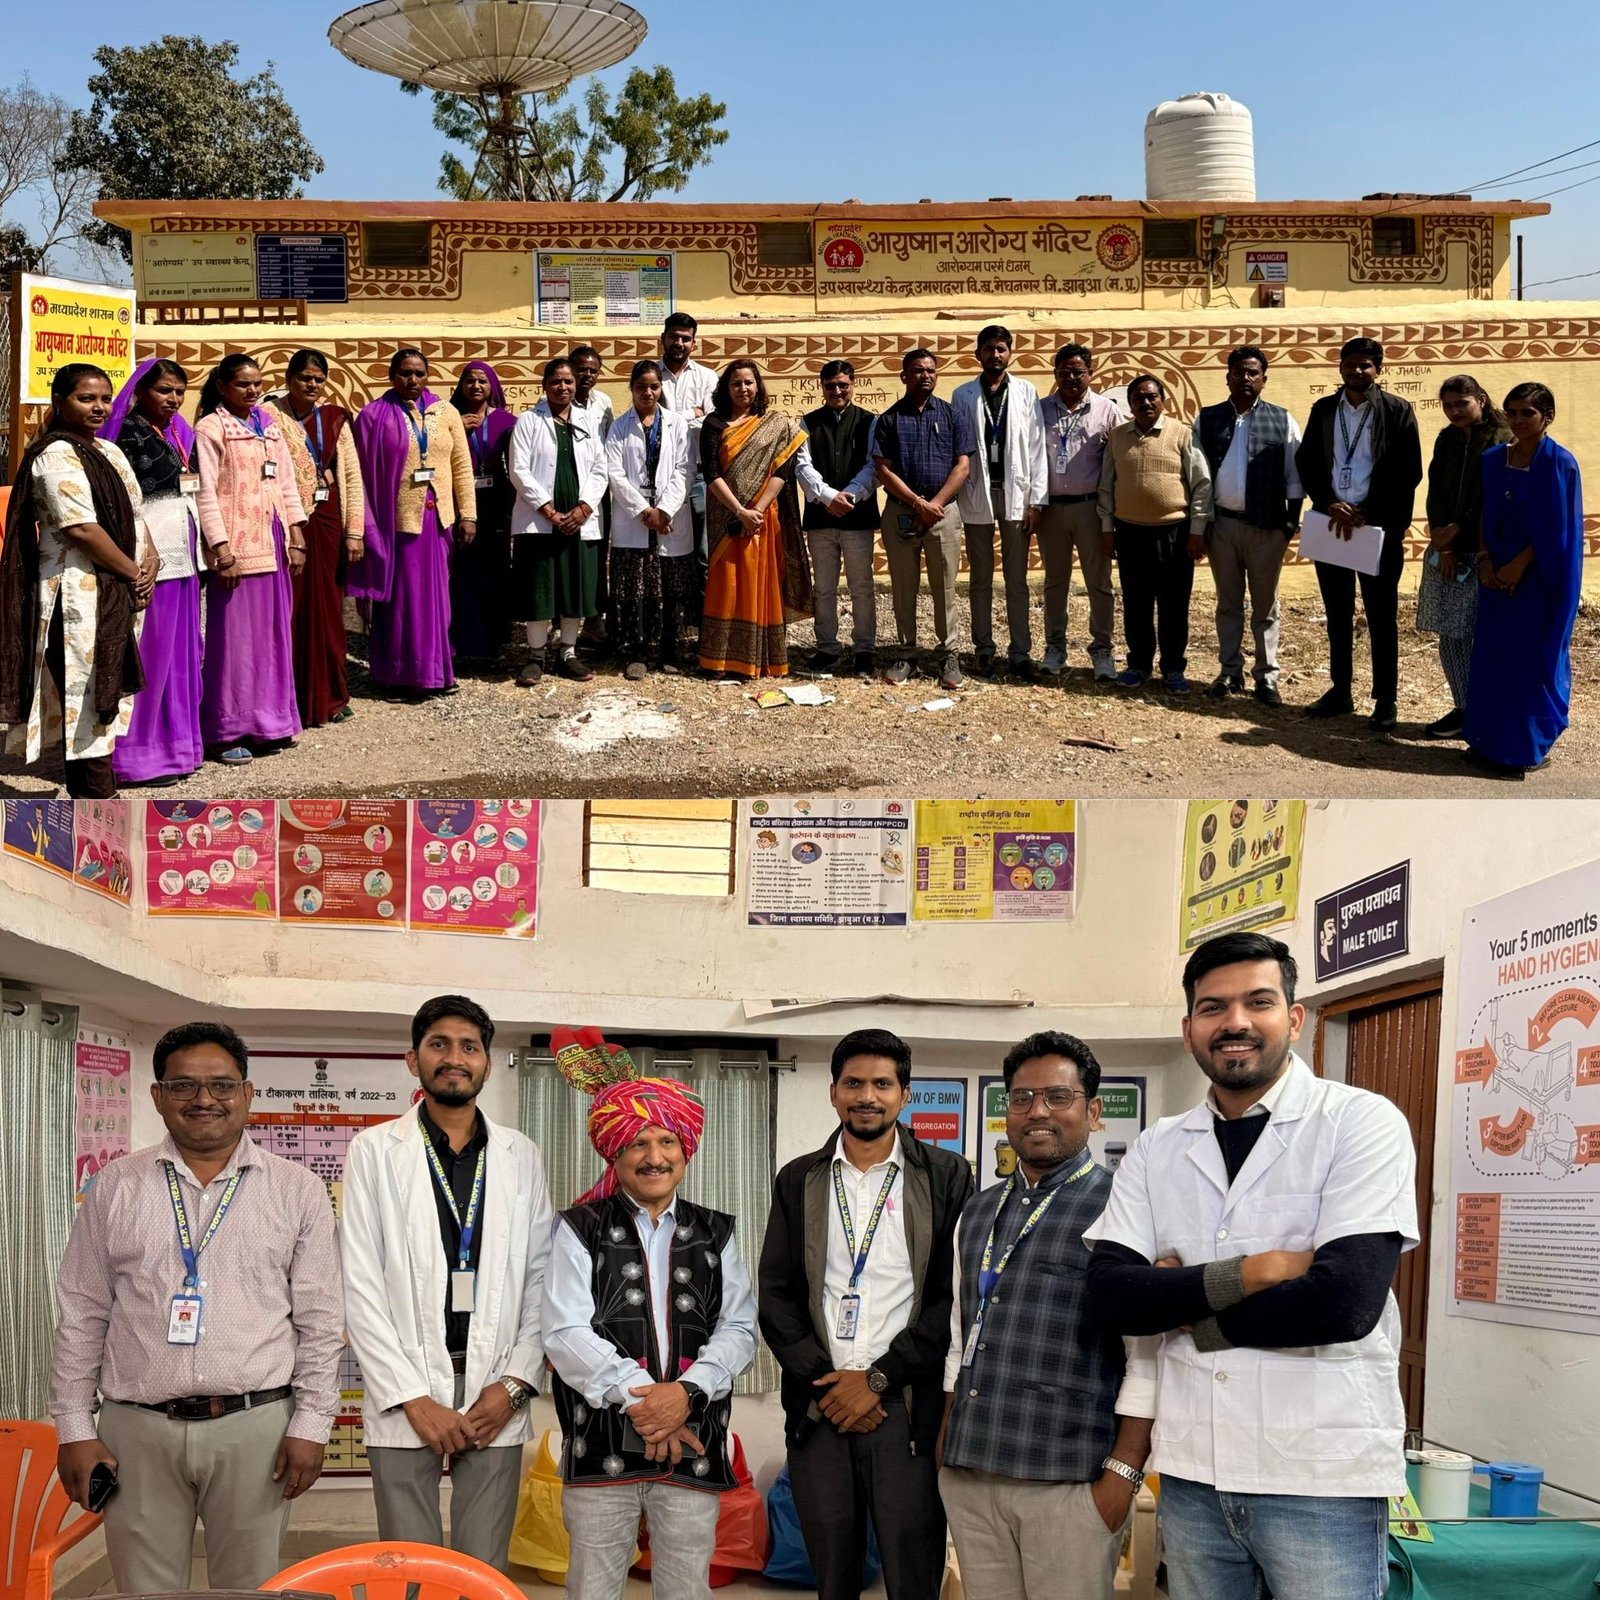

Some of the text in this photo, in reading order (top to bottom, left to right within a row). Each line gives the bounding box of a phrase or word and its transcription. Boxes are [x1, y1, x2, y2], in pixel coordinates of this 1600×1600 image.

[867, 231, 955, 262] आयुष्मान
[956, 224, 1028, 254] आरोग्य
[1032, 223, 1093, 254] मंदिर
[49, 302, 114, 321] मध्यप्रदेश शासन
[76, 326, 106, 356] आरोग्य
[107, 329, 129, 358] मंदिर
[36, 366, 47, 376] उप
[873, 820, 906, 828] (NPPCD)
[1340, 884, 1402, 930] पुरुष प्रसाधन
[1342, 920, 1399, 955] MALE TOILET
[1489, 912, 1598, 961] Your 5 moments
[1498, 938, 1600, 986] HAND HYGIEN
[1532, 1025, 1544, 1042] 2
[1457, 1057, 1464, 1077] 1
[1579, 1056, 1588, 1078] 4
[266, 1086, 305, 1099] टीकाकरण
[344, 1088, 357, 1100] वर्ष
[923, 1092, 935, 1105] OF
[938, 1092, 960, 1105] BMW
[913, 1122, 957, 1131] SEGREGATION
[1483, 1121, 1493, 1140] 3
[1580, 1133, 1588, 1155] 5
[875, 1176, 893, 1207] HEALTH
[1458, 1197, 1464, 1211] 1
[1458, 1218, 1464, 1232] 2
[1457, 1239, 1463, 1253] 3
[1457, 1258, 1462, 1273] 4
[1456, 1280, 1463, 1293] 5
